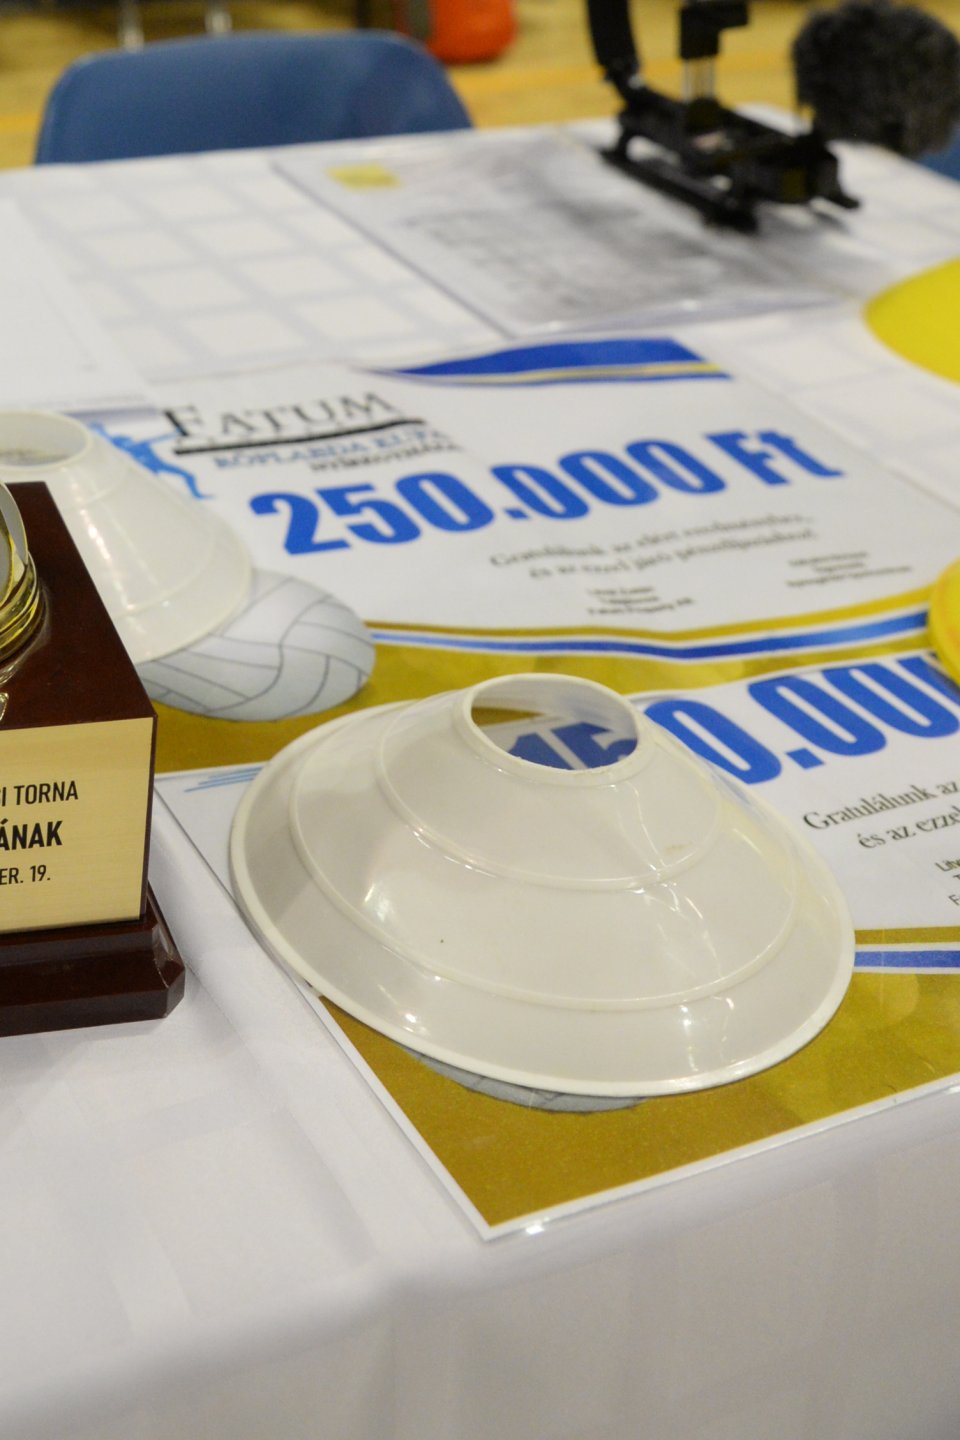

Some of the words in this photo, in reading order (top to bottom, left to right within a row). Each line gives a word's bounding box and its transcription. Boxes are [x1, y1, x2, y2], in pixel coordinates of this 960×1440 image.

[164, 391, 406, 443] FATUM
[247, 439, 727, 555] 250.000
[707, 429, 845, 486] Ft
[14, 780, 79, 806] TORNA
[803, 784, 938, 830] Gratulálunk
[857, 833, 886, 849] és
[886, 826, 916, 841] az
[29, 864, 51, 883] 19.
